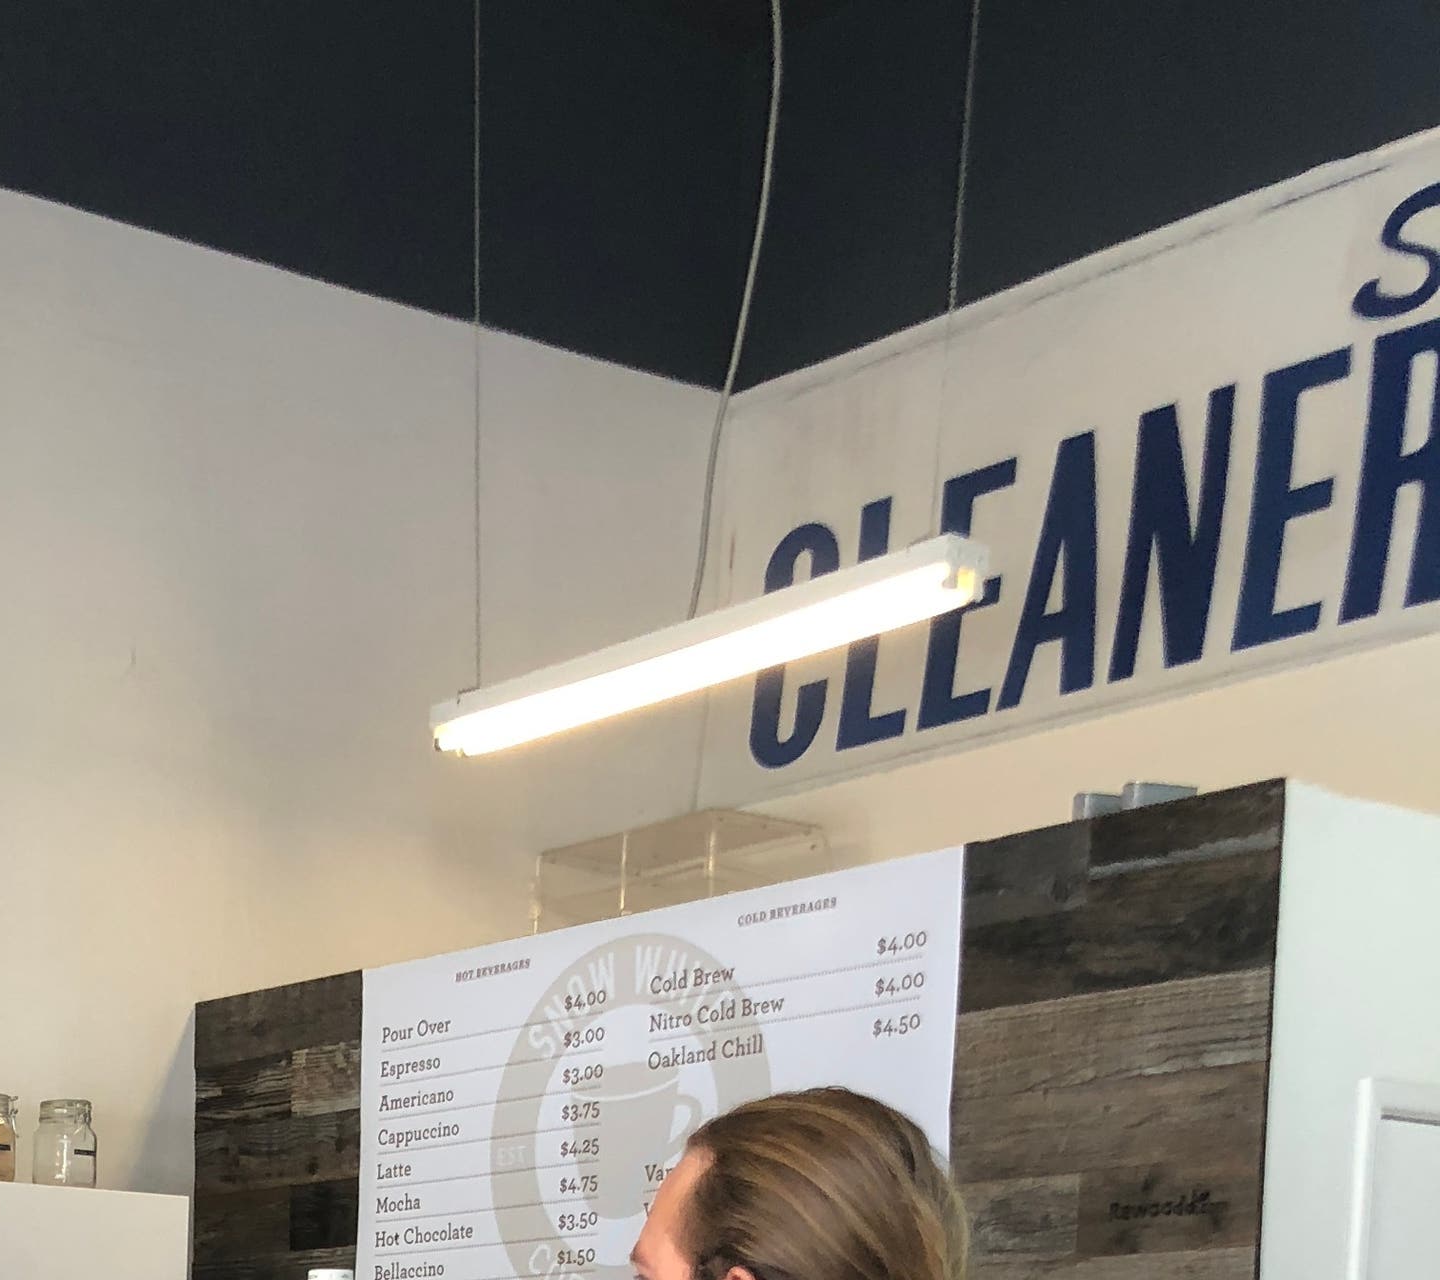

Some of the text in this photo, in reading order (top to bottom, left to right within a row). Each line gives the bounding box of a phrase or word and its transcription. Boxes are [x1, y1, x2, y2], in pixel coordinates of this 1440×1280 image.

[737, 897, 838, 927] COLD BEVERAGES
[877, 931, 927, 955] $4.00
[455, 958, 531, 983] HOT BEVERAGES
[650, 966, 735, 995] Cold Brew
[875, 972, 925, 997] $4.00
[564, 989, 607, 1011] $4.00
[648, 996, 784, 1033] Nitro Cold Brew
[872, 1013, 921, 1037] $4.50
[382, 1019, 451, 1044] Pour Over
[563, 1027, 605, 1049] $3.00
[648, 1034, 764, 1070] Oakland Chill
[380, 1057, 441, 1079] Espresso
[562, 1064, 603, 1085] $3.00
[378, 1089, 455, 1112] Americano
[561, 1101, 601, 1122] $3.75
[378, 1123, 460, 1147] Cappuccino
[560, 1138, 600, 1158] $4.25
[376, 1162, 412, 1180] Latte
[559, 1175, 599, 1195] $4.75
[375, 1193, 421, 1214] Mocha
[558, 1211, 598, 1231] $3.50
[375, 1223, 473, 1248] Hot Chocolate
[557, 1248, 596, 1266] $1.50
